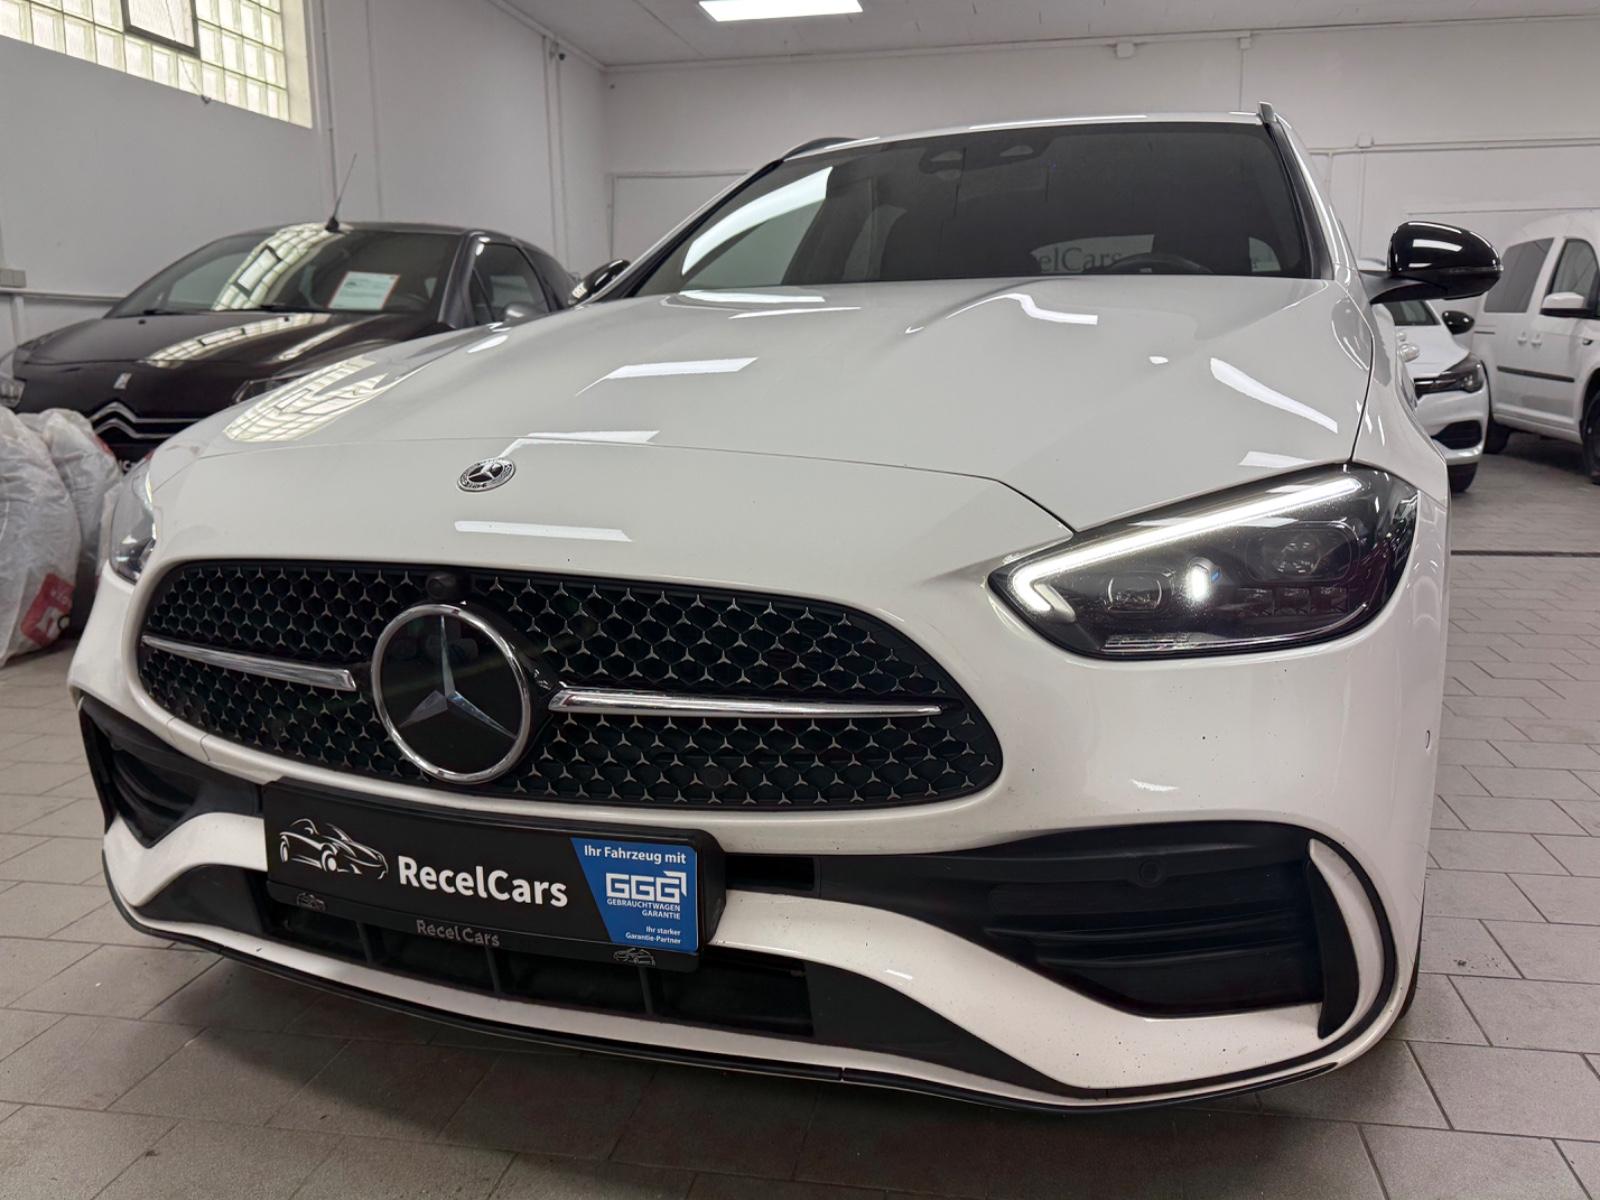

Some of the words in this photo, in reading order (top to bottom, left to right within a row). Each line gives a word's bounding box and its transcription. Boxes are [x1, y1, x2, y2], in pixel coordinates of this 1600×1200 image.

[584, 845, 602, 857] Ihr
[604, 846, 662, 864] Fahrzeug
[664, 851, 687, 864] mit
[397, 855, 569, 908] RecelCars
[605, 872, 680, 904] GGG
[606, 898, 681, 912] GEBRAUCHTWAGEN
[641, 909, 681, 920] GARANTIE
[645, 926, 656, 934] Ihr
